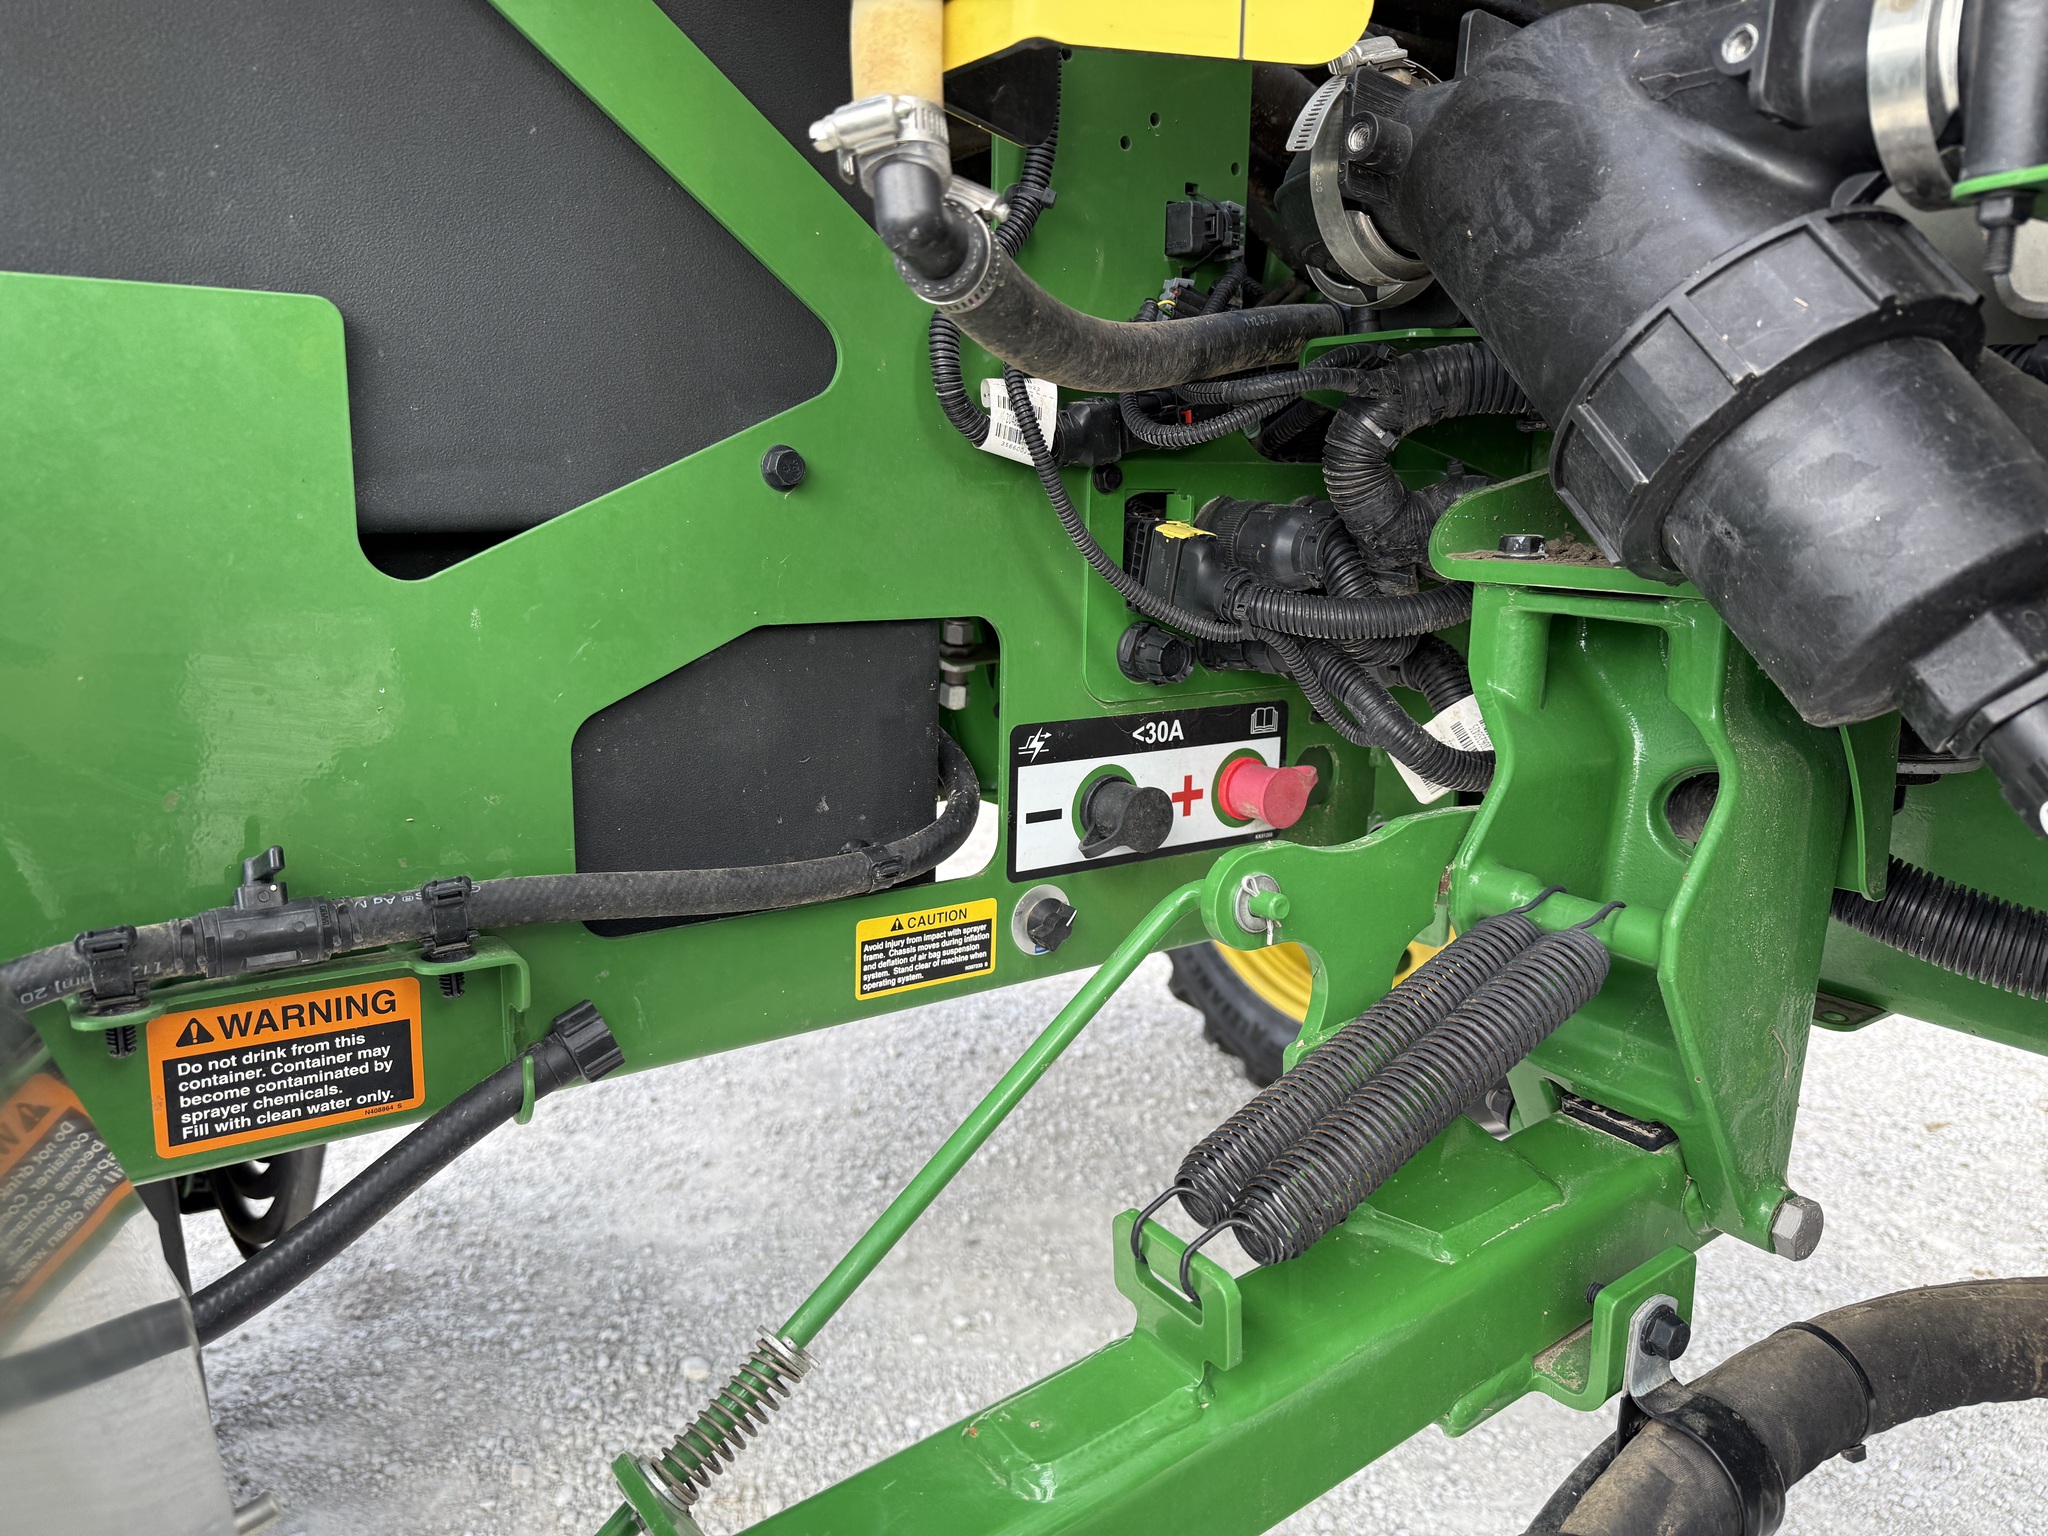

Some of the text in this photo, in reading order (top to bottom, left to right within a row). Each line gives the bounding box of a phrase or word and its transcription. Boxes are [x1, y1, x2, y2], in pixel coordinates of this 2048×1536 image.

[1132, 719, 1184, 743] <30A
[907, 908, 968, 928] CAUTION
[863, 932, 990, 962] frame. Chassis moves during inflation
[864, 924, 987, 952] Avoid injury from impact with sprayer
[863, 943, 980, 971] and deflation of air bag suspension
[863, 951, 987, 982] system. Stand clear of machine when
[863, 972, 924, 991] operating system.
[217, 989, 397, 1040] WARNING
[178, 1034, 365, 1076] Do not drink from this
[179, 1046, 390, 1091] container. Container may
[180, 1060, 392, 1108] become contaminated by
[182, 1085, 342, 1124] sprayer chemicals.
[183, 1090, 394, 1139] Fill with clean water only.
